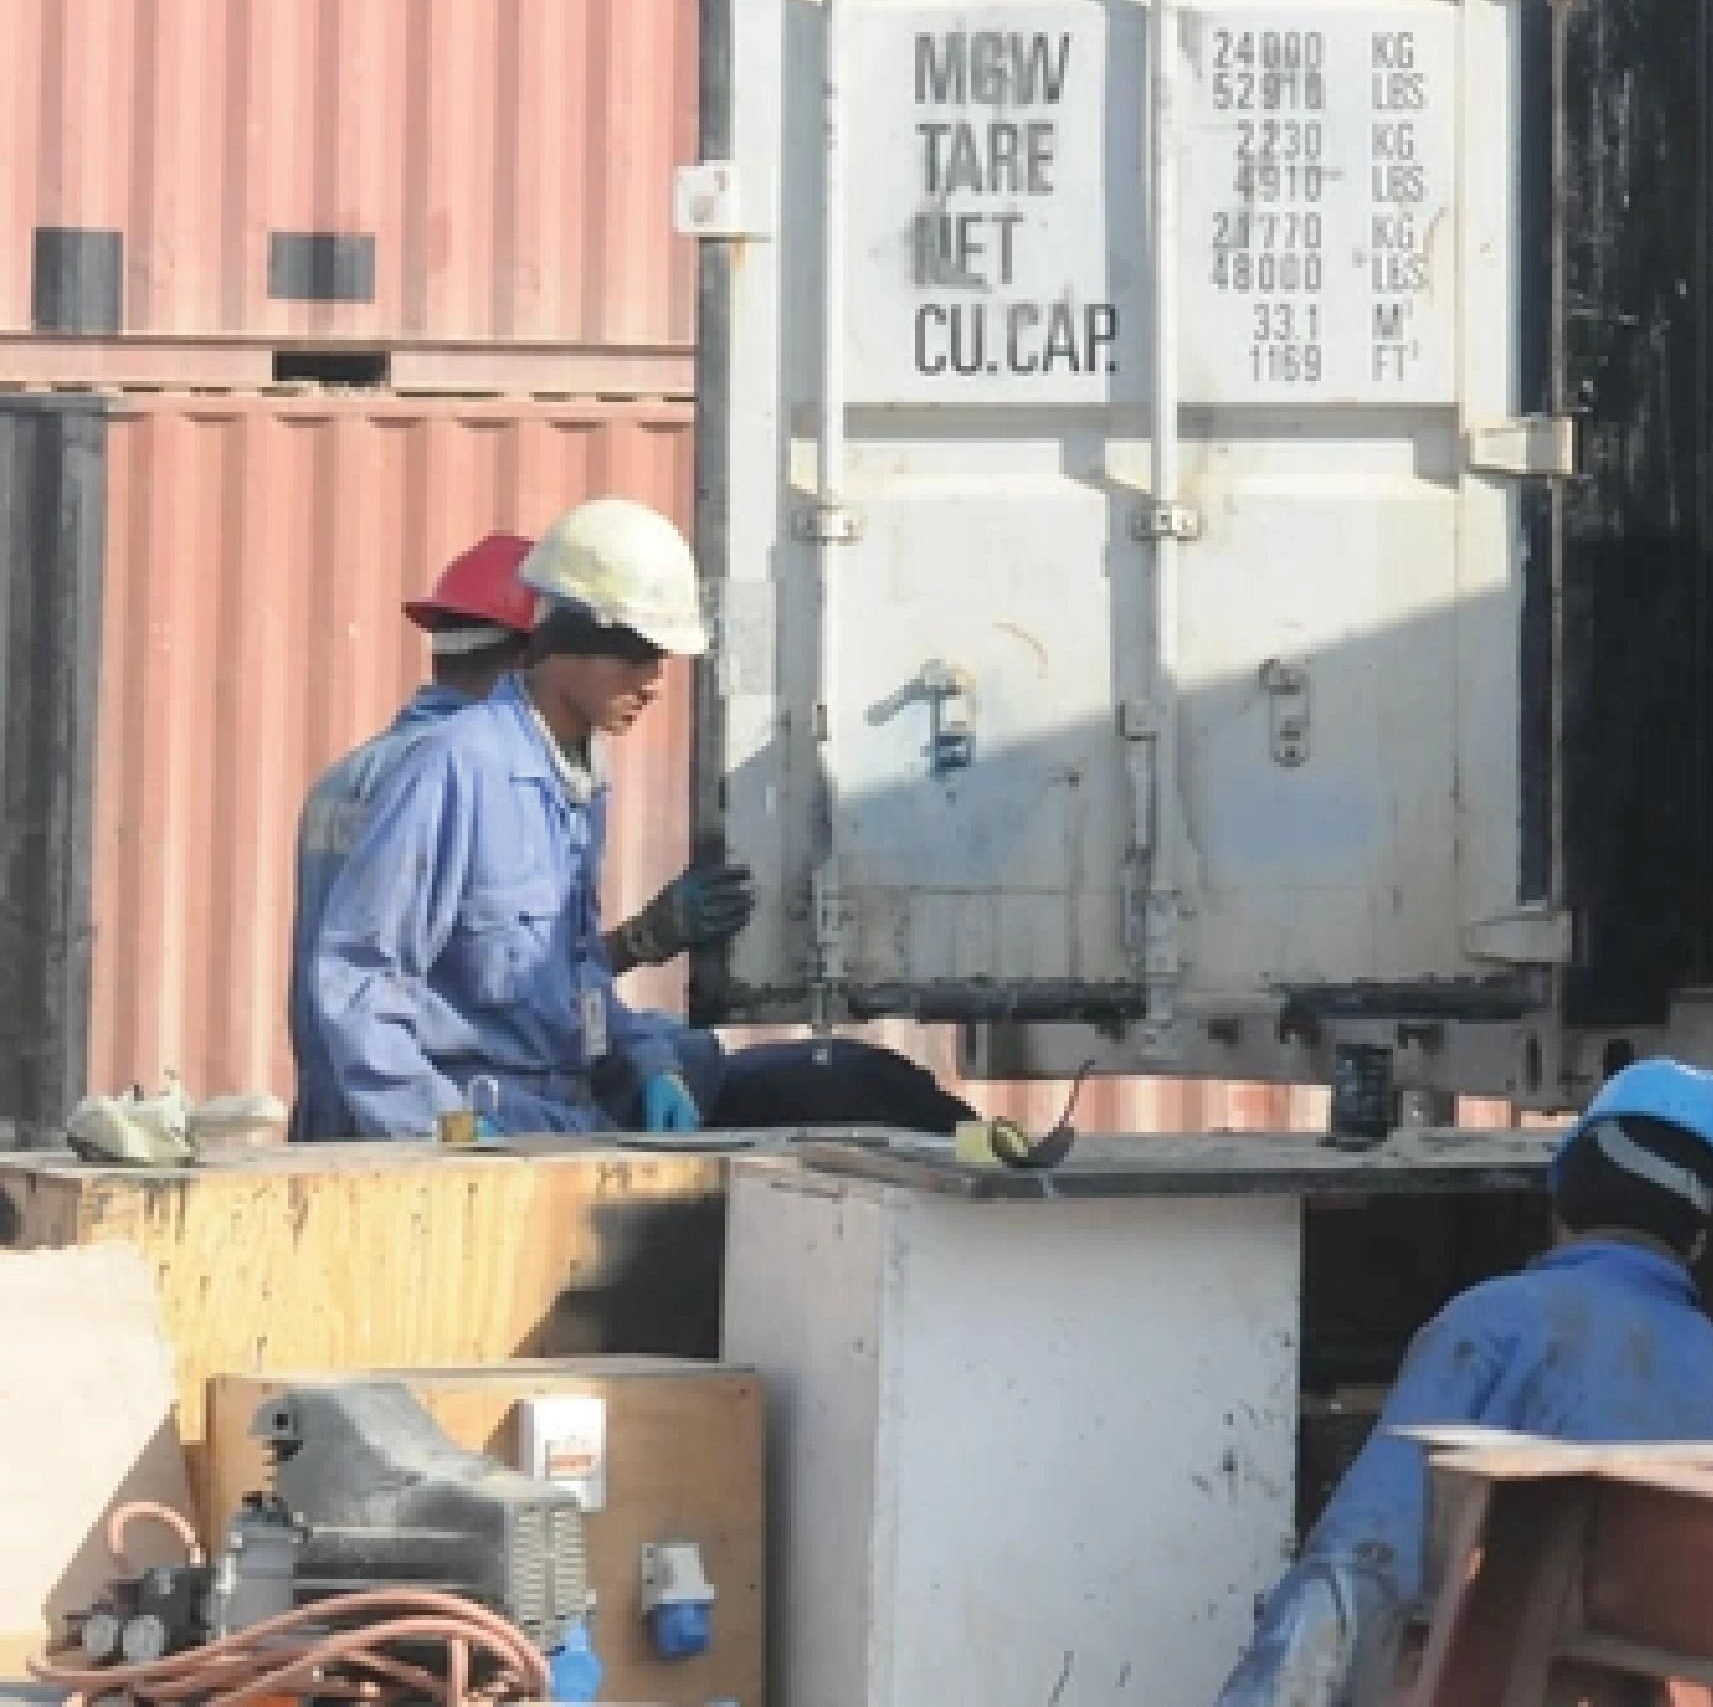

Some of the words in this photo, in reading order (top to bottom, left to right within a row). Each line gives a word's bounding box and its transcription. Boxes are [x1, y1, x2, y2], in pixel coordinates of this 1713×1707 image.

[914, 31, 1071, 105] MGW
[1212, 30, 1324, 69] 24000
[1371, 31, 1414, 69] KG
[1371, 72, 1426, 110] LBS
[914, 123, 1054, 193] TARE
[1237, 120, 1323, 160] 2230
[1371, 122, 1414, 160] KG
[1233, 165, 1323, 203] 4910
[1371, 165, 1426, 203] LBS
[914, 211, 1025, 286] NET
[1371, 211, 1414, 249] KG
[1210, 252, 1323, 291] 48000
[1371, 252, 1427, 291] LBS
[1253, 303, 1318, 341] 33.1
